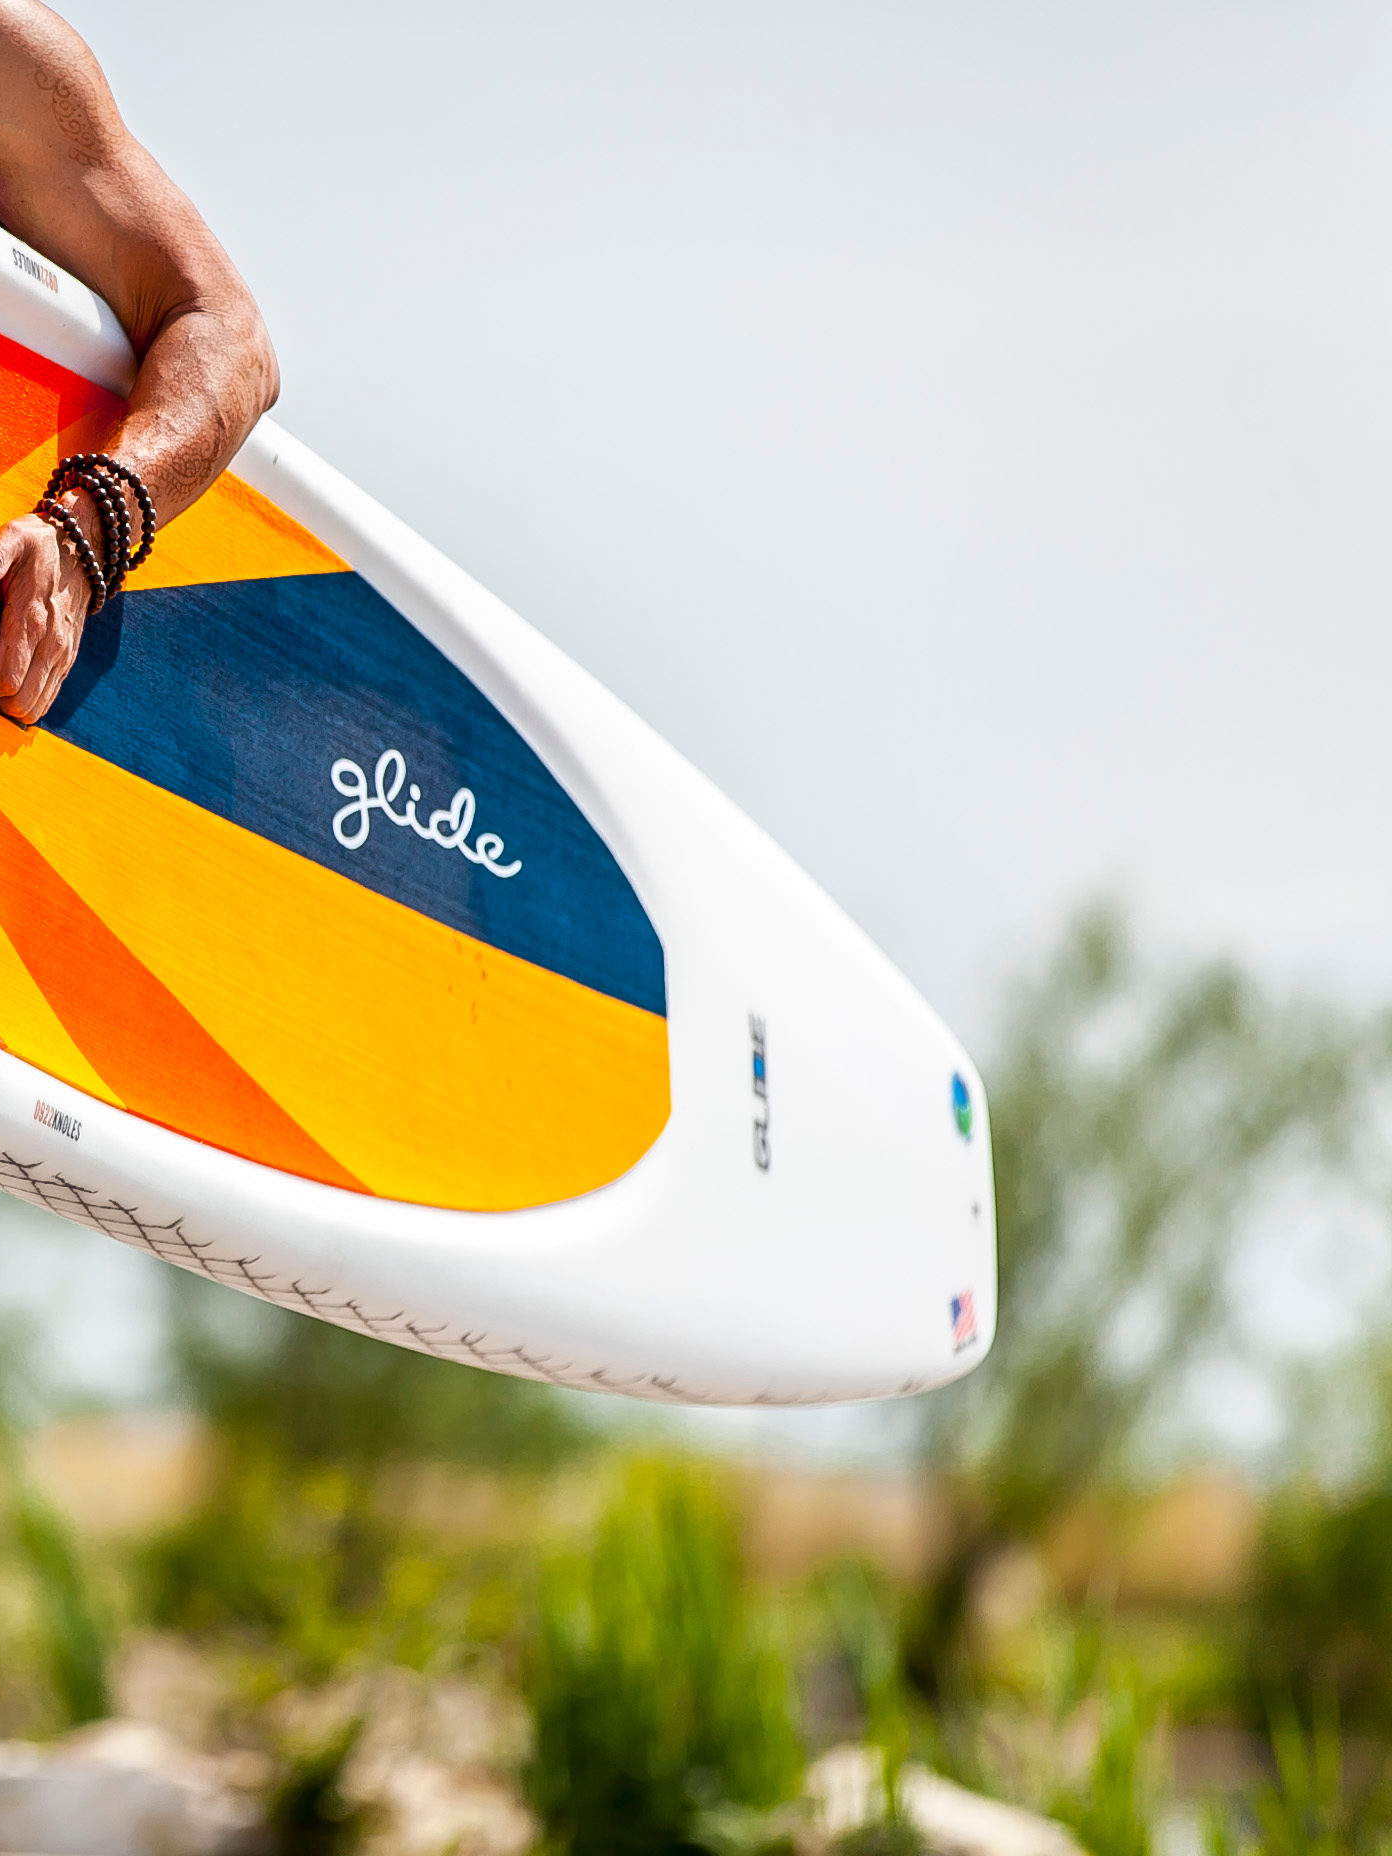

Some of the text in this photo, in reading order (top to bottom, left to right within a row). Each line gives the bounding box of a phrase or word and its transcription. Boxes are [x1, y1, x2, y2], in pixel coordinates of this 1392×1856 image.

[12, 248, 58, 294] 0922KNOLES
[330, 748, 523, 880] glide
[33, 1099, 82, 1142] 0922KNOLES
[748, 1008, 771, 1174] GLIDE
